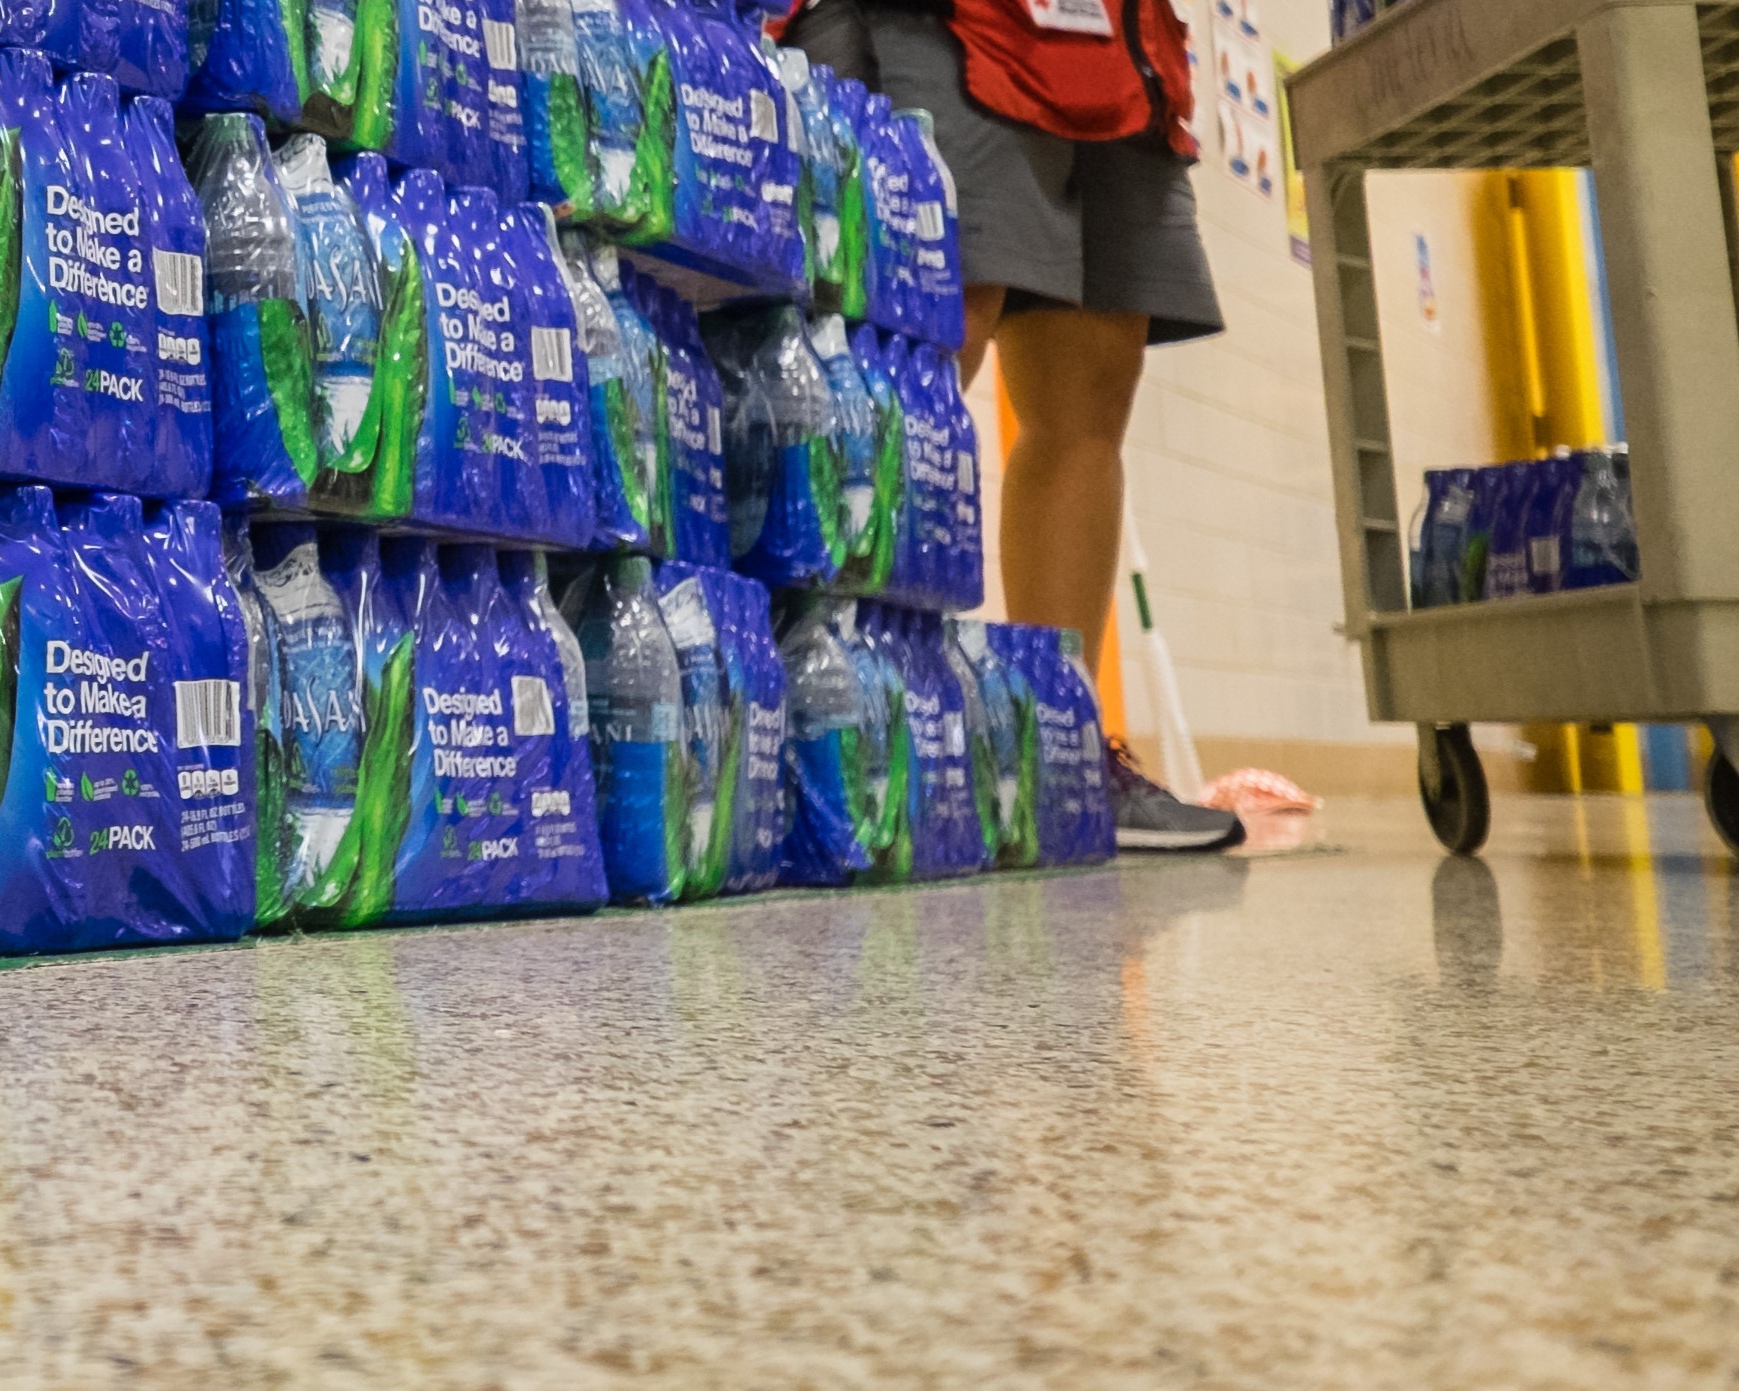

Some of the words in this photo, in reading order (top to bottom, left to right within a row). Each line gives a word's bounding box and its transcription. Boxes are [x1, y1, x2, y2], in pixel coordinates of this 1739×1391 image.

[45, 222, 73, 253] to
[76, 226, 121, 270] Make
[127, 249, 142, 273] a
[49, 256, 148, 309] Difference
[436, 283, 510, 322] Desed
[440, 312, 463, 339] to
[500, 332, 514, 352] a
[445, 341, 523, 382] Diffence
[85, 369, 143, 402] 24PACK
[46, 640, 149, 684] Designed
[44, 682, 75, 715] to
[80, 681, 132, 716] Make
[131, 694, 147, 718] a
[284, 677, 366, 747] DASA
[47, 719, 158, 753] Difference
[428, 717, 447, 745] to
[497, 726, 509, 746] a
[433, 748, 516, 778] Difference
[89, 826, 156, 856] 24PACK
